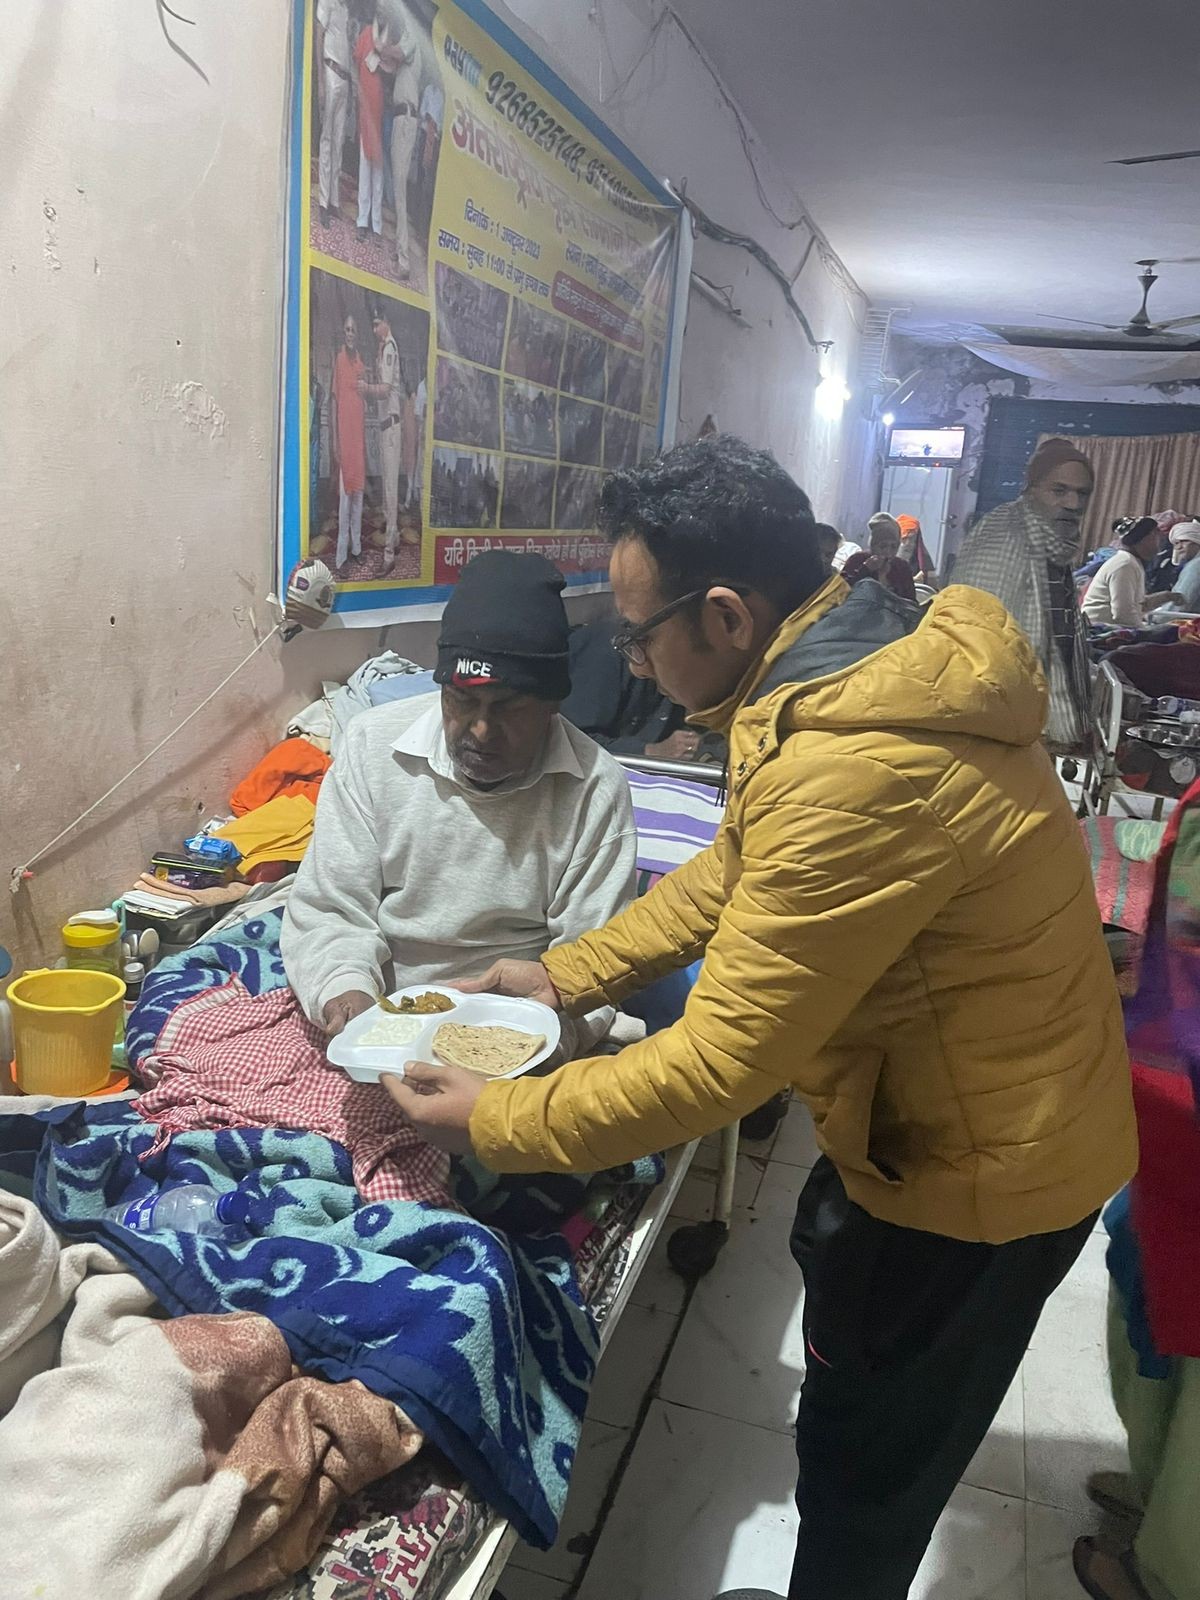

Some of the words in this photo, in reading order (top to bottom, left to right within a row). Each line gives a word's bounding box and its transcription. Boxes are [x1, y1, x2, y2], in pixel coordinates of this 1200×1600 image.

[464, 198, 490, 231] दिनांक
[438, 229, 460, 254] समय
[467, 243, 486, 269] सुबह
[444, 538, 464, 567] यदि
[456, 658, 493, 678] NICE
